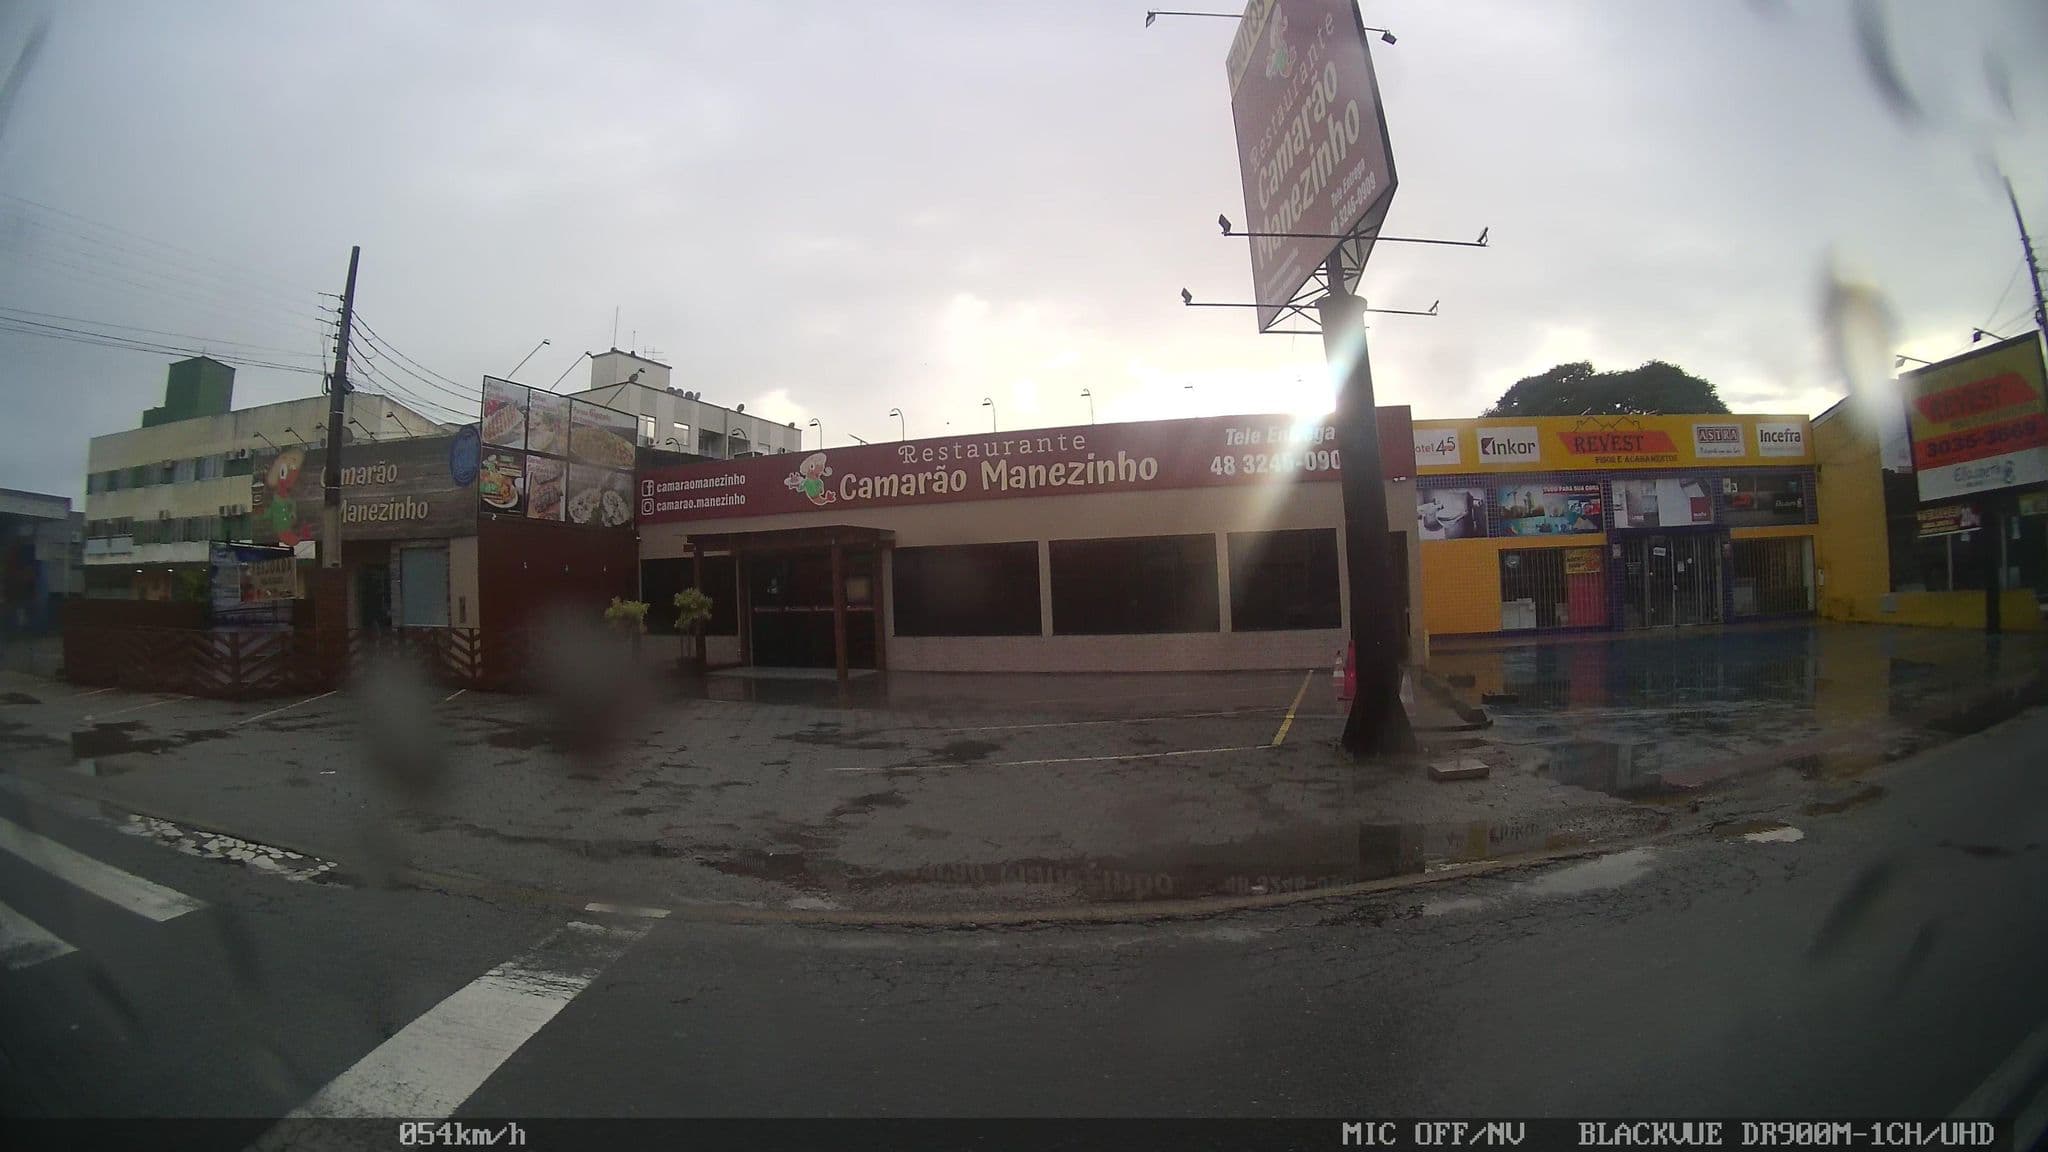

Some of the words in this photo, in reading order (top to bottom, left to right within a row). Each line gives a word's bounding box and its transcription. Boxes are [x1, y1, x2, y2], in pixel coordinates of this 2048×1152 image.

[1249, 12, 1335, 174] Restaurante
[1259, 61, 1338, 211] Camarão
[1256, 99, 1360, 270] Manezinho
[1225, 427, 1258, 446] Tele
[1575, 433, 1644, 454] REVEST
[1699, 428, 1738, 441] ASTRA
[1760, 428, 1801, 442] Incefra
[898, 434, 1086, 464] Restaurante
[1491, 438, 1536, 456] Inkor
[320, 460, 398, 488] Cmarão
[840, 465, 968, 501] Camarão
[980, 451, 1158, 492] Manezinho
[1210, 455, 1236, 476] 48
[656, 474, 746, 493] camaraomanezinho
[656, 493, 746, 512] camarao.manezinho
